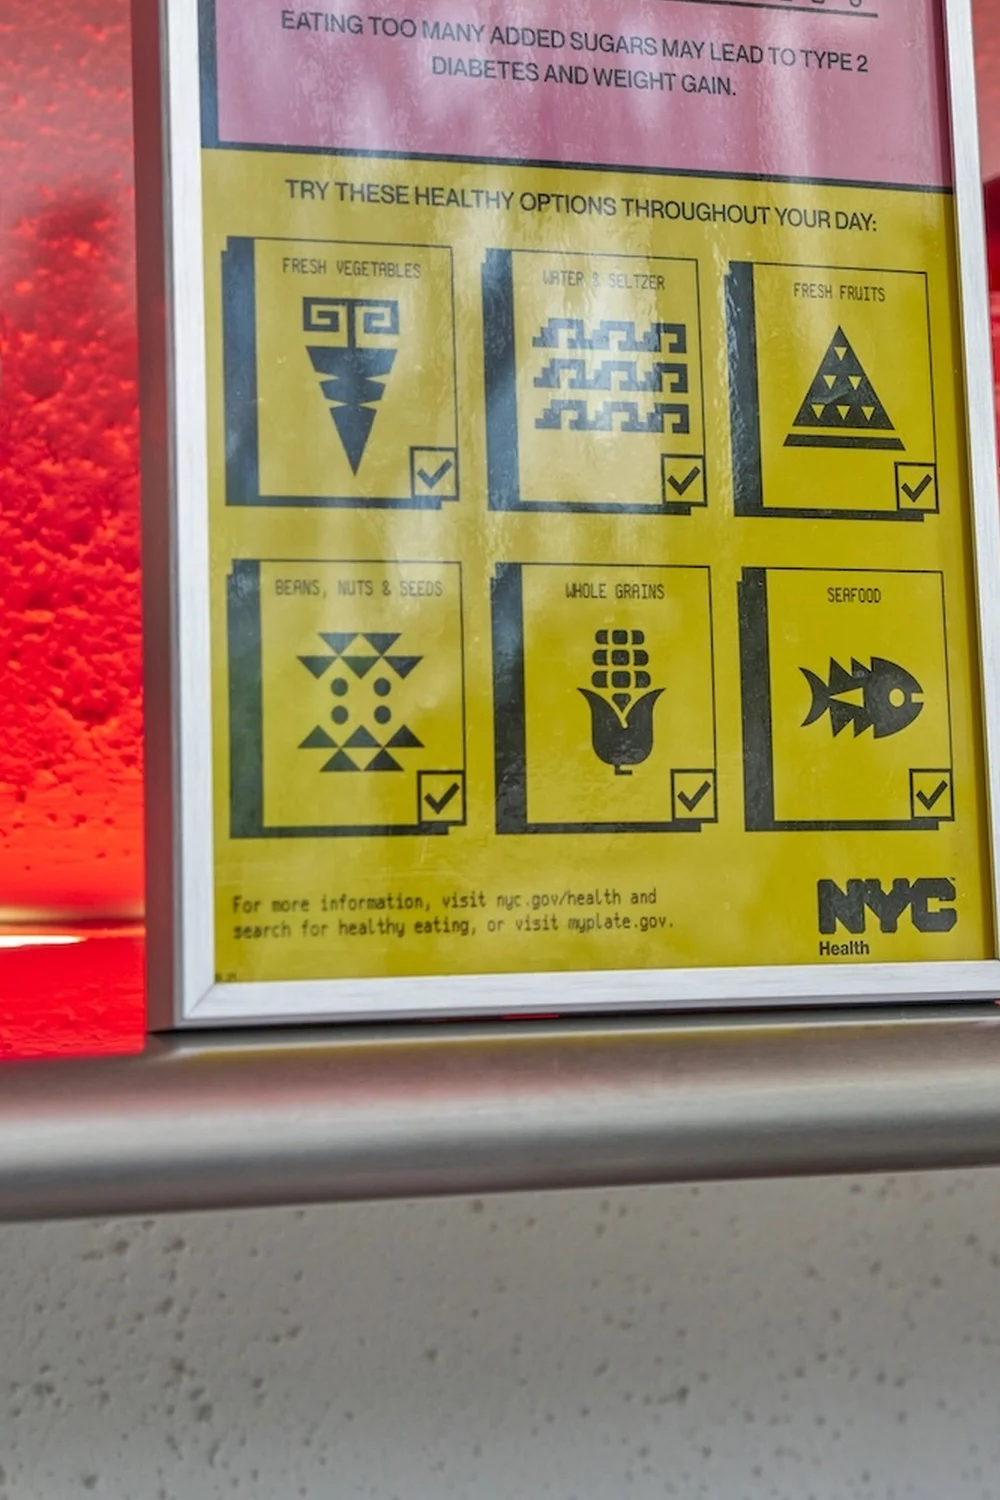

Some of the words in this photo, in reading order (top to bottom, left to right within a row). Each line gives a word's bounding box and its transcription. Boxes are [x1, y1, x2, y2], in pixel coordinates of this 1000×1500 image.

[280, 9, 364, 35] EATING
[368, 15, 418, 38] TOO
[422, 20, 486, 43] MANY
[489, 26, 566, 50] ADDED
[570, 31, 658, 57] SUGARS
[662, 38, 706, 60] MAY
[709, 42, 764, 65] LEAD
[767, 46, 797, 67] TO
[799, 49, 854, 72] TYPE
[856, 55, 869, 73] 2
[431, 55, 540, 82] DIABETES
[544, 64, 589, 86] AND
[592, 68, 677, 92] WEIGHT
[681, 74, 737, 97] GAIN.
[285, 179, 330, 201] TRY
[335, 181, 410, 206] THESE
[415, 185, 514, 211] HEALTHY
[519, 191, 617, 218] OPTIONS
[620, 197, 770, 225] THROUGHOUT
[774, 207, 831, 229] YOUR
[834, 210, 878, 233] DAY:
[282, 257, 327, 274] FRESH
[336, 259, 422, 279] VEGETABLES
[542, 269, 585, 287] WATER
[591, 272, 600, 288] &
[608, 273, 666, 291] SELTZER
[793, 282, 833, 300] FRESH
[839, 284, 886, 303] FRUITS
[274, 578, 328, 599] BEANS,
[337, 579, 374, 597] NUTS
[381, 579, 392, 597] &
[400, 579, 444, 598] SEEDS
[565, 582, 608, 600] WHOLE
[614, 583, 666, 601] GRAINS
[826, 586, 882, 604] SEAFOOD
[232, 894, 262, 914] For
[270, 898, 310, 914] more
[320, 892, 431, 913] information,
[442, 890, 487, 909] visit
[496, 888, 621, 911] nyc.gov/health
[629, 887, 657, 906] and
[816, 877, 958, 935] NYC
[233, 920, 292, 940] search
[301, 919, 329, 937] for
[338, 916, 406, 938] healthy
[413, 915, 478, 937] eating,
[487, 918, 505, 933] or
[515, 913, 560, 932] visit
[567, 910, 675, 934] myplate.gov.
[818, 940, 871, 956] Health
